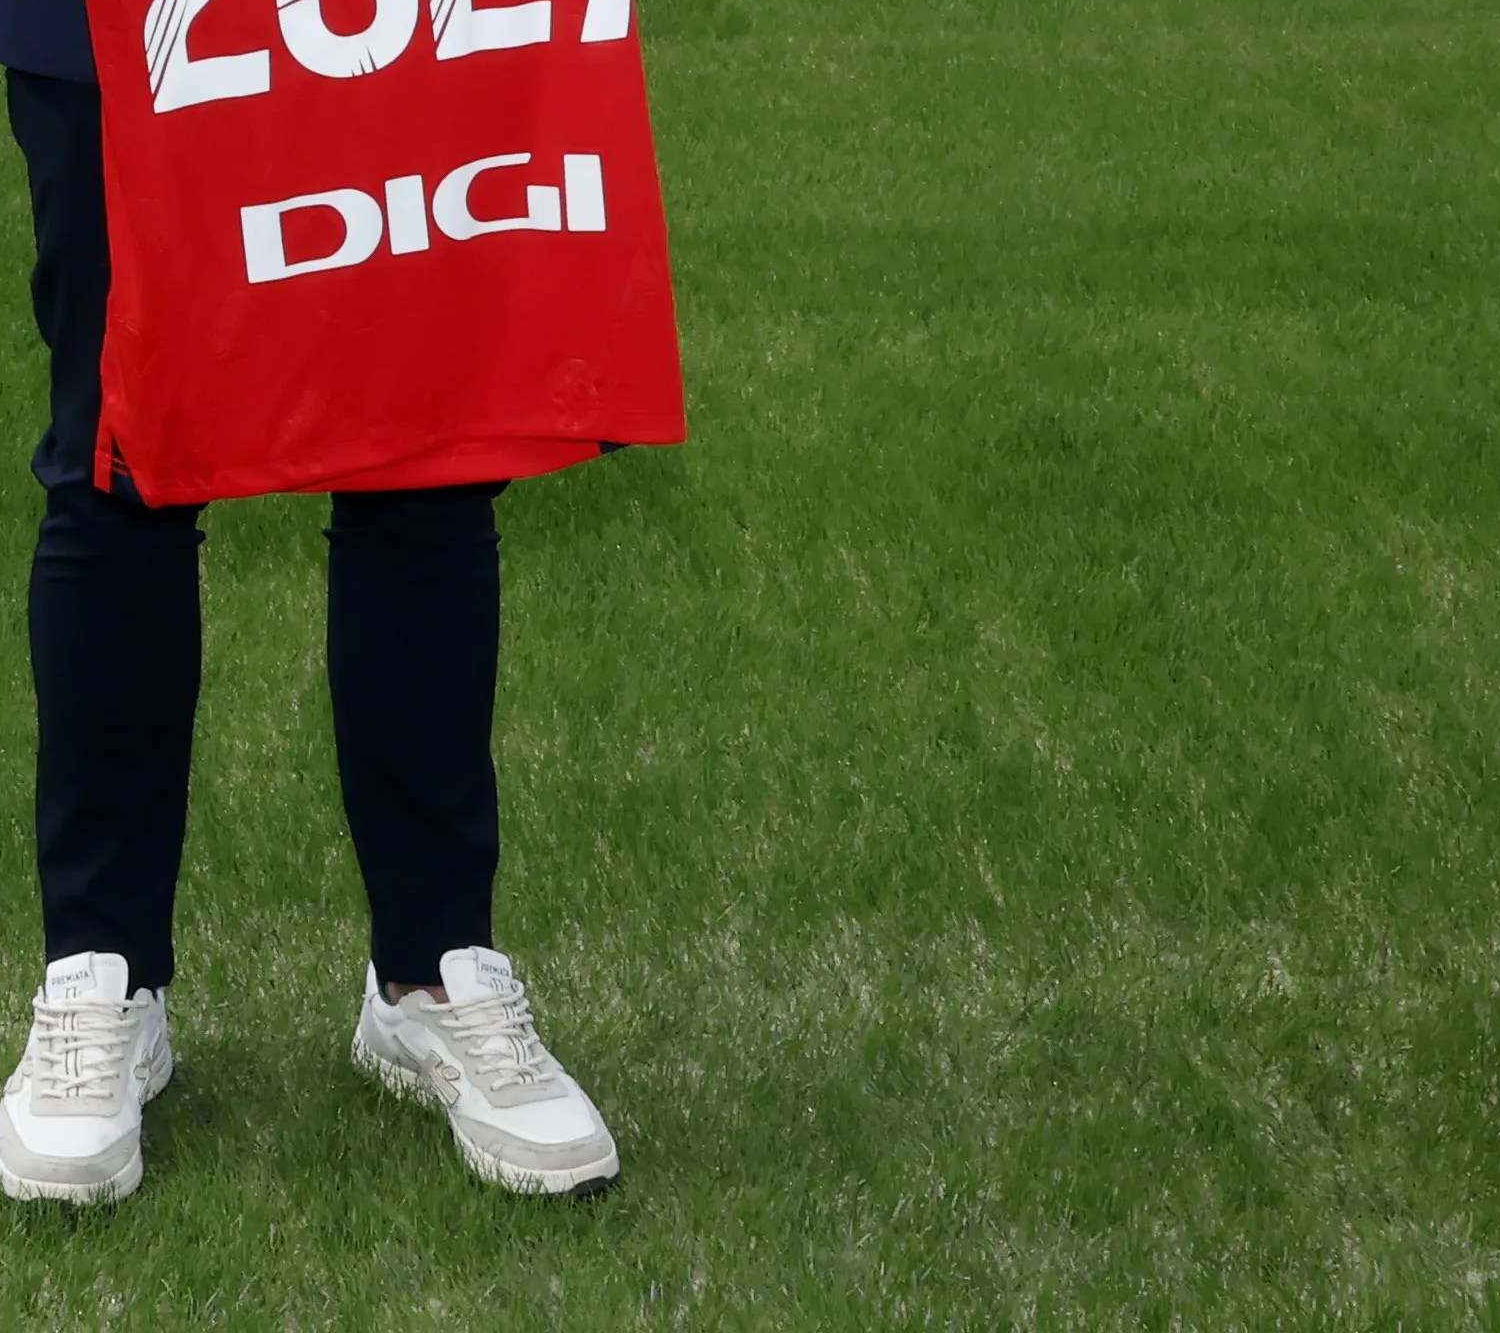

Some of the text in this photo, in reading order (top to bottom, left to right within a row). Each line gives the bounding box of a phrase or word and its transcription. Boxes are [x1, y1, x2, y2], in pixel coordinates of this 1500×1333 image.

[240, 152, 607, 284] DIGI
[481, 963, 509, 977] PREMIATA
[51, 971, 89, 985] PREMIATA
